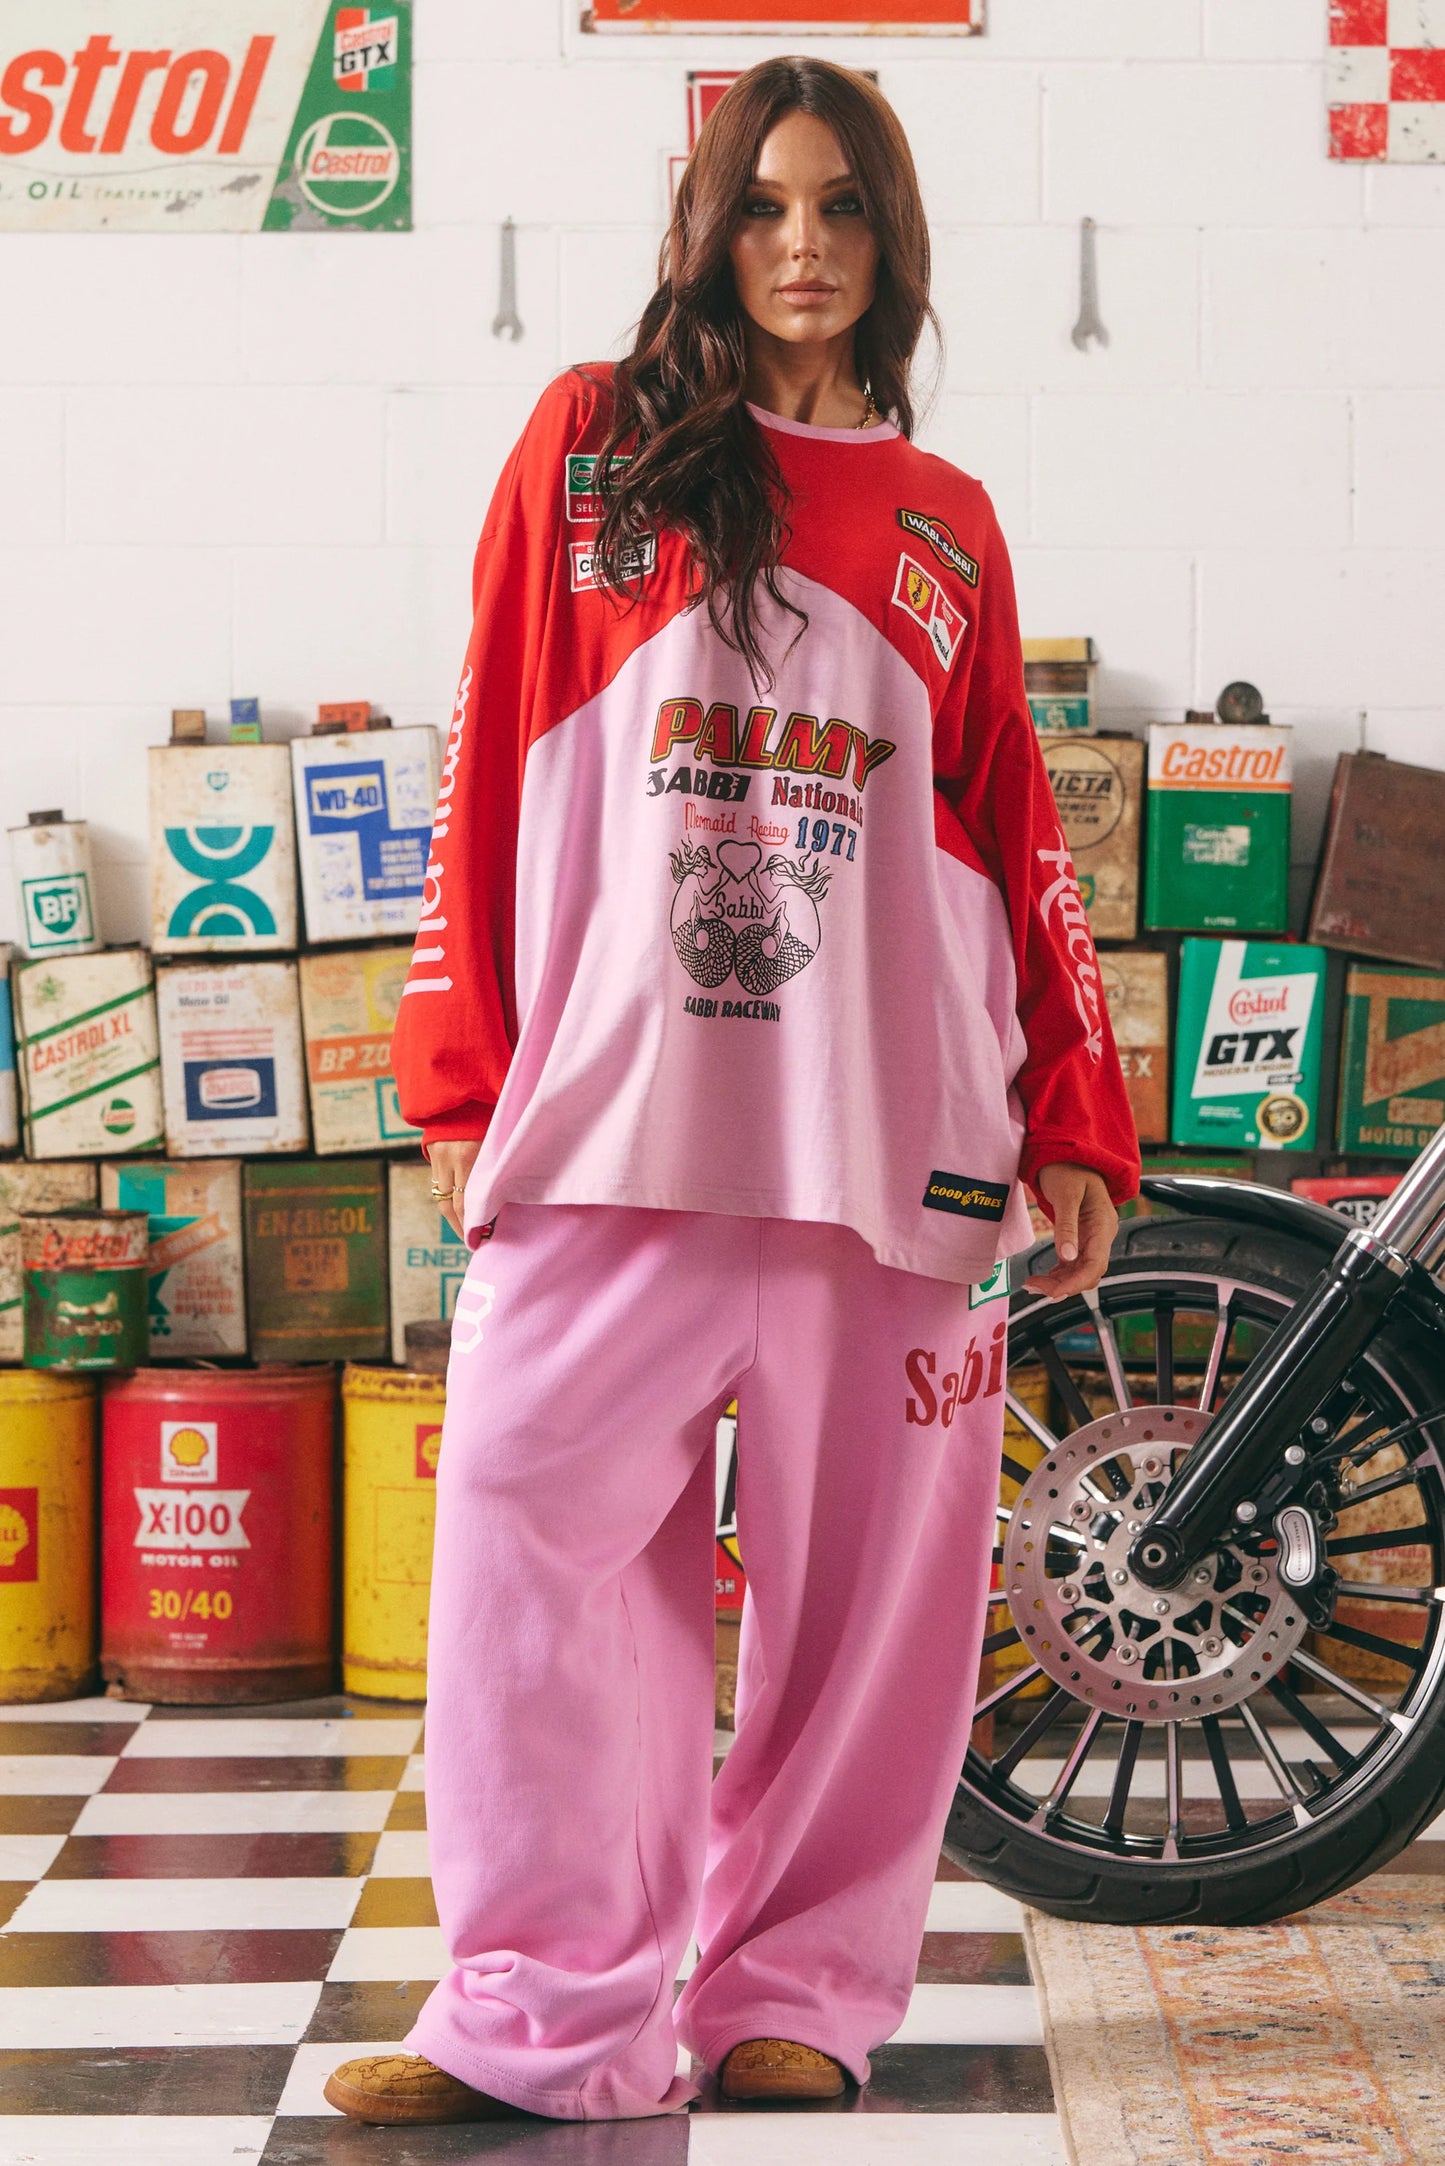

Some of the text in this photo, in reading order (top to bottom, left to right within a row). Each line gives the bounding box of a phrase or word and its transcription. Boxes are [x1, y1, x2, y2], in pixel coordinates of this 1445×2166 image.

[340, 22, 393, 51] Castrol
[340, 40, 391, 74] GTX
[312, 149, 393, 177] Castrol
[28, 181, 81, 200] OIL
[906, 515, 972, 576] WABI-SABBI
[649, 696, 897, 792] PALMY
[1161, 741, 1286, 781] Castrol
[316, 785, 379, 812] WD-40
[646, 766, 752, 803] SABBI
[771, 776, 864, 828] Nationals
[684, 802, 790, 846] Mermaid Racing
[795, 816, 857, 863] 1977
[39, 892, 80, 926] BP
[708, 892, 766, 920] Sabbi
[683, 995, 782, 1023] SABBI RACEWAY
[1228, 984, 1290, 1027] Castrol
[33, 1023, 106, 1074] CASTROL
[110, 1011, 134, 1041] XL
[1206, 1028, 1300, 1067] GTX
[318, 1045, 357, 1074] BP
[1203, 1065, 1251, 1079] MODERN
[1358, 1125, 1415, 1147] MOTOR
[930, 1184, 1004, 1209] GOOD VIBES
[257, 1206, 373, 1238] ENERGOL
[1332, 1200, 1386, 1227] CR
[42, 1230, 132, 1261] Castrol
[148, 1503, 231, 1536] X-100
[140, 1553, 240, 1569] MOTOR OIL
[148, 1588, 234, 1622] 30/40
